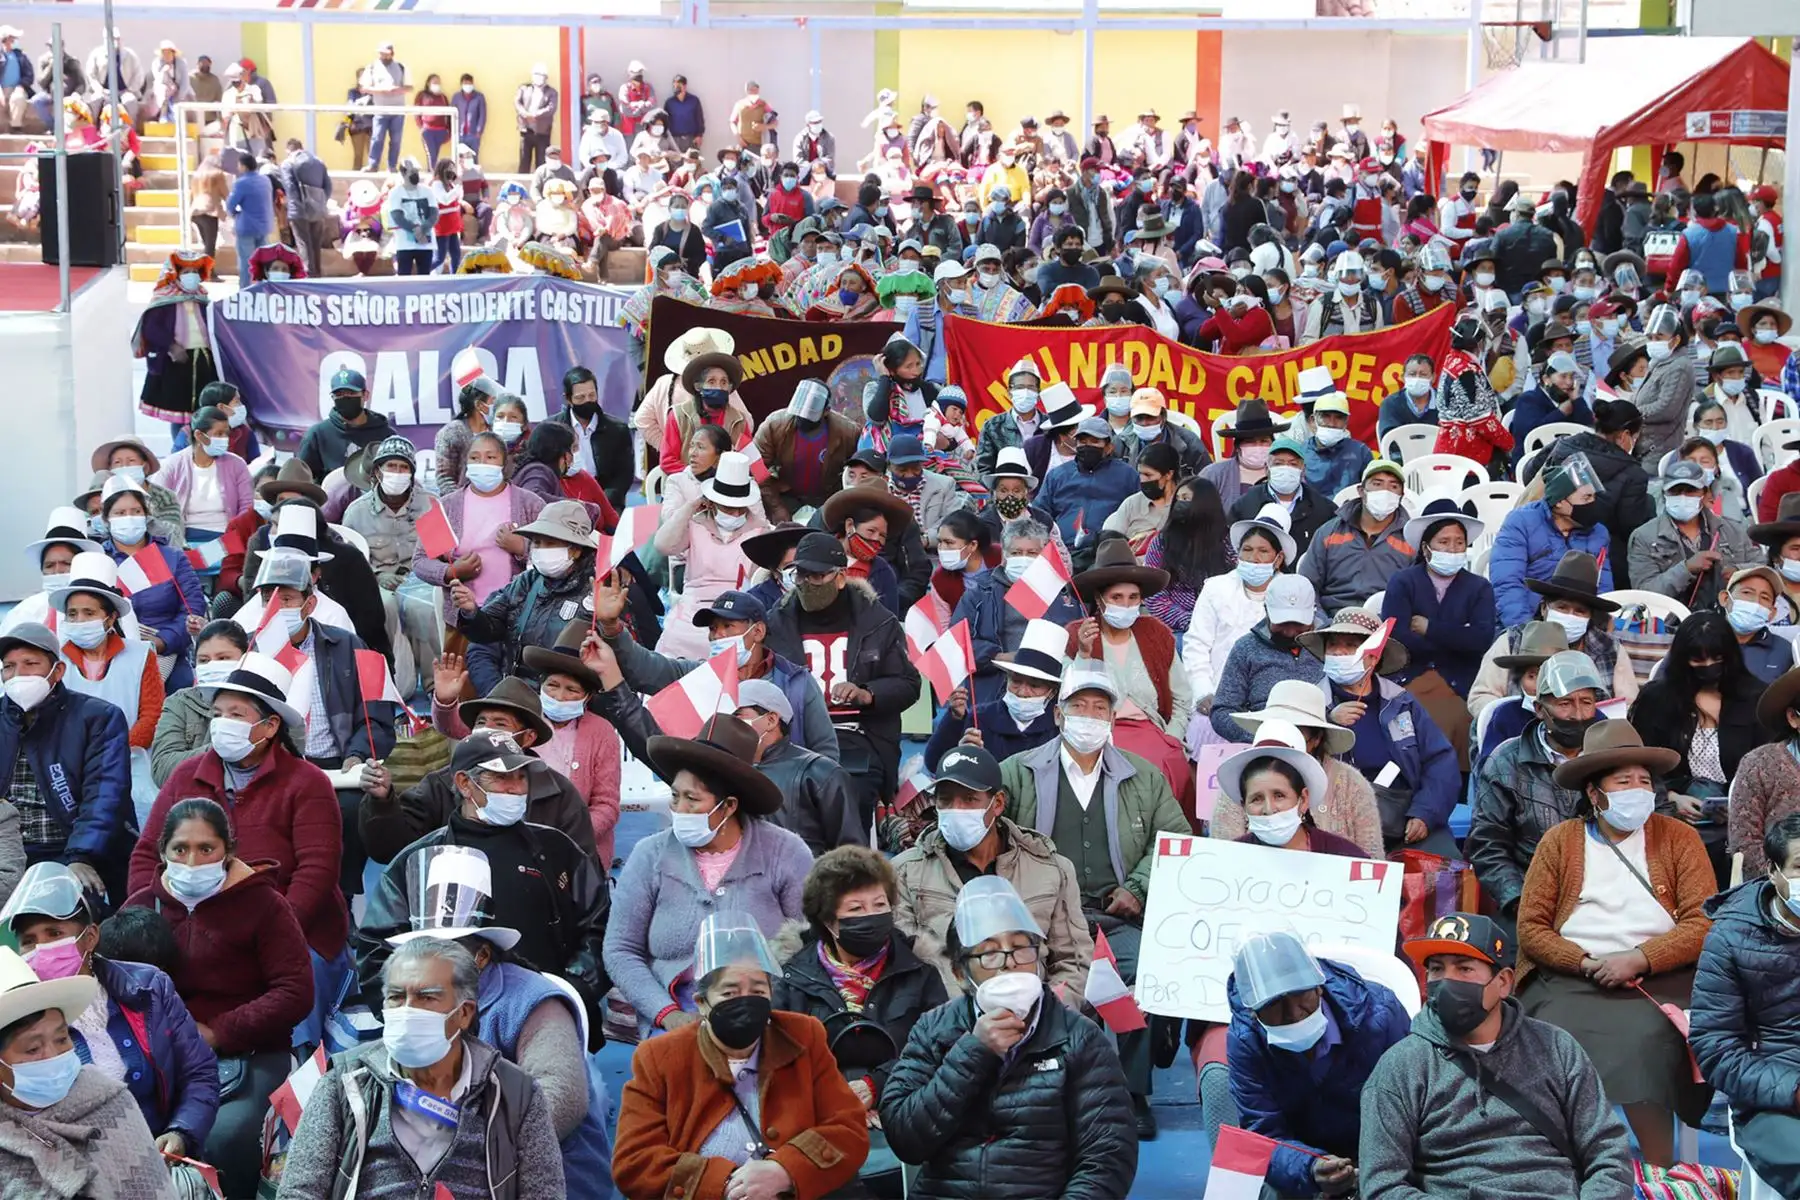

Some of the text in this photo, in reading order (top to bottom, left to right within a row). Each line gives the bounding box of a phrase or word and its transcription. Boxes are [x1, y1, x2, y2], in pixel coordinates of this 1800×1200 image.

[222, 292, 324, 327] GRACIAS
[327, 290, 400, 327] SEÑOR
[405, 289, 537, 325] PRESIDENTE
[738, 333, 843, 382] NIDAD
[49, 762, 78, 814] nautica
[1177, 852, 1369, 924] Gracias
[422, 1097, 442, 1112] Face
